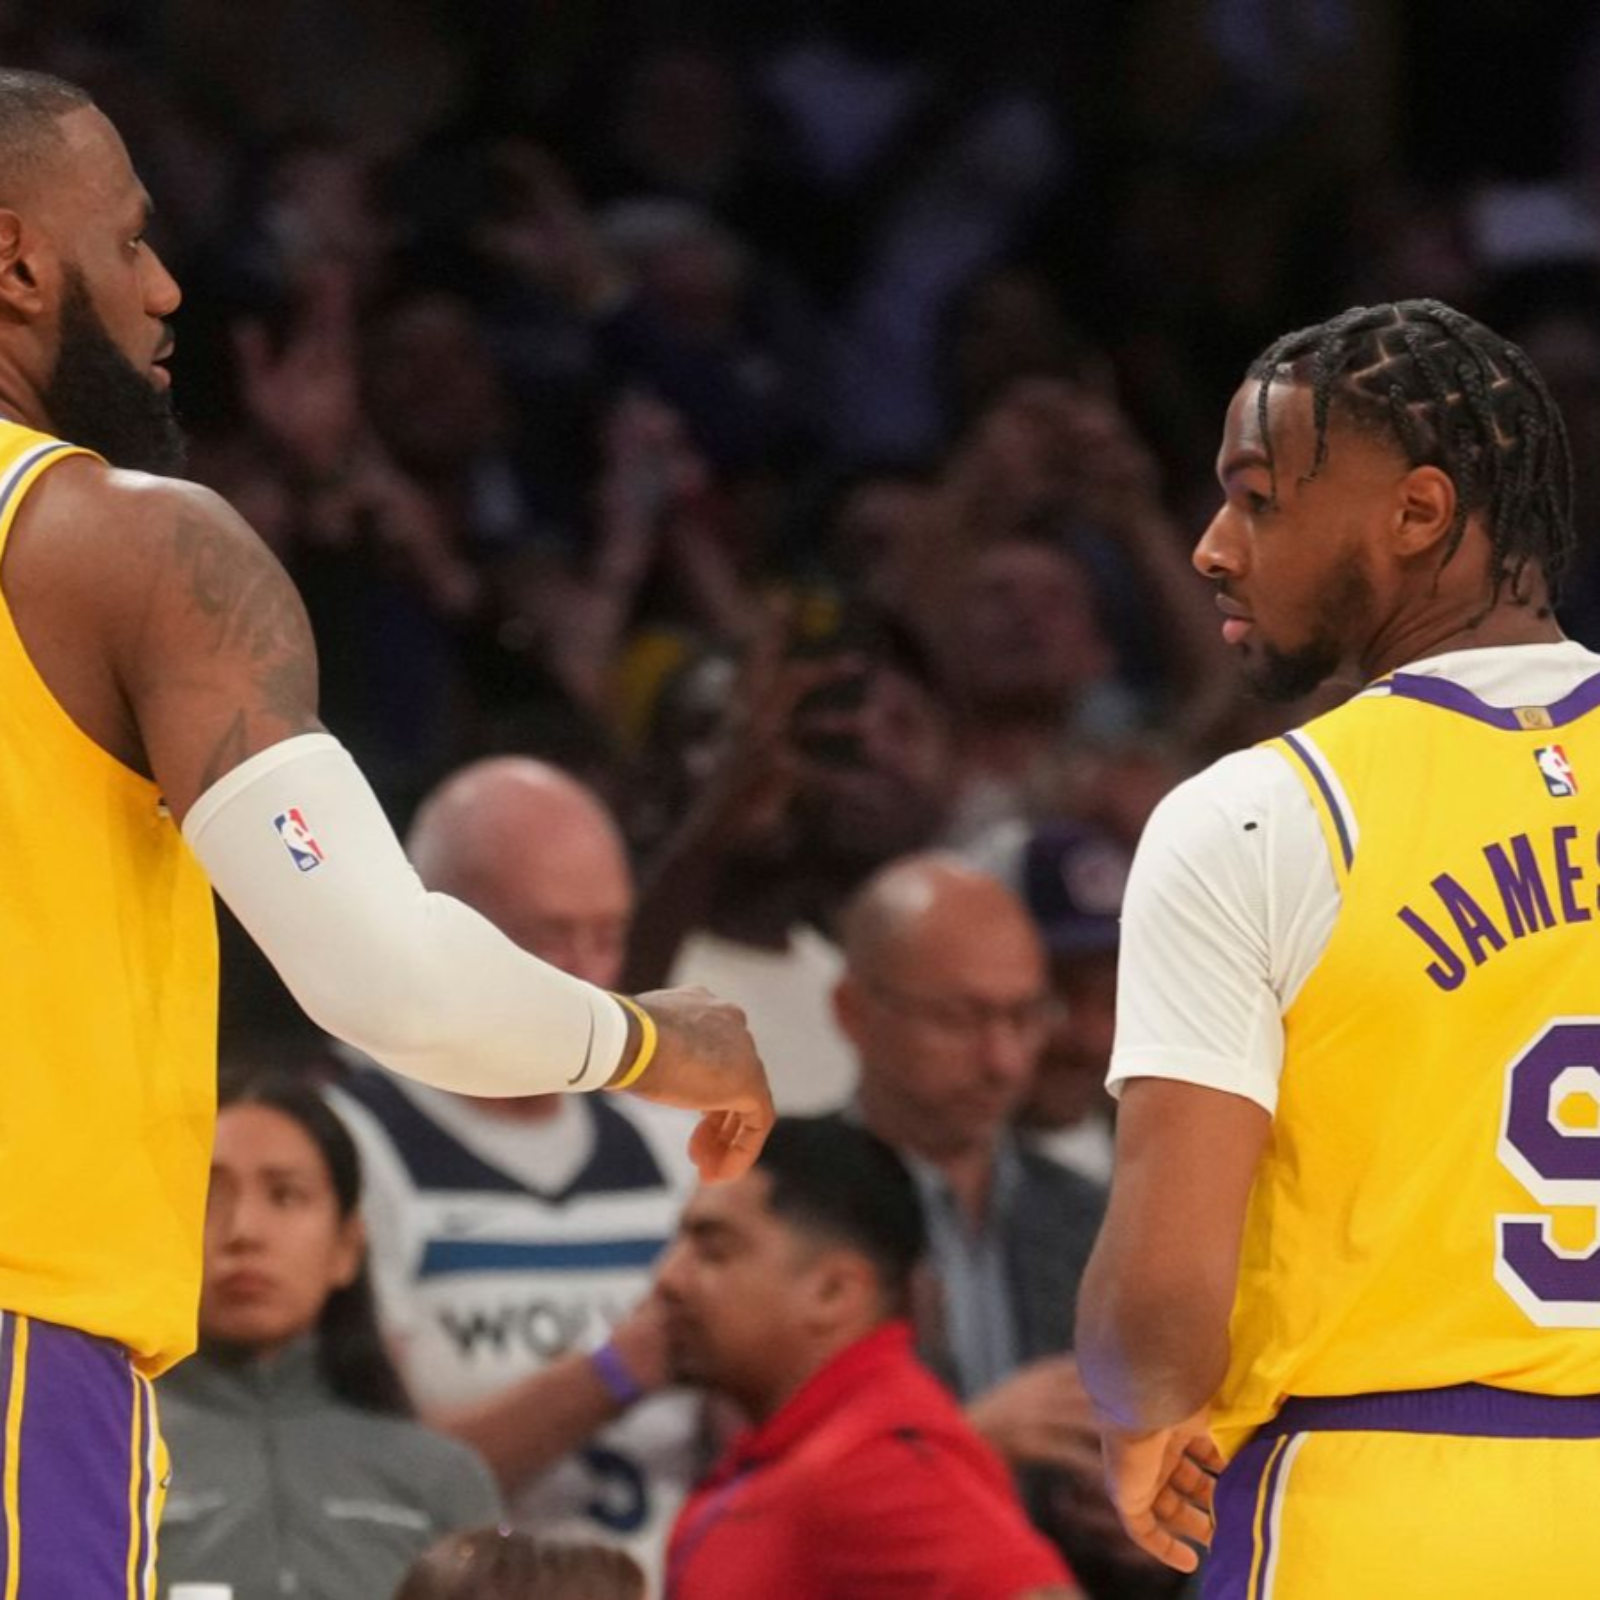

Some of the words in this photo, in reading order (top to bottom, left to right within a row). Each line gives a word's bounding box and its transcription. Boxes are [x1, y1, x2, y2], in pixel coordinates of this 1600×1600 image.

[1396, 825, 1600, 991] JAME
[1494, 1014, 1600, 1329] 9
[437, 1299, 616, 1362] WO
